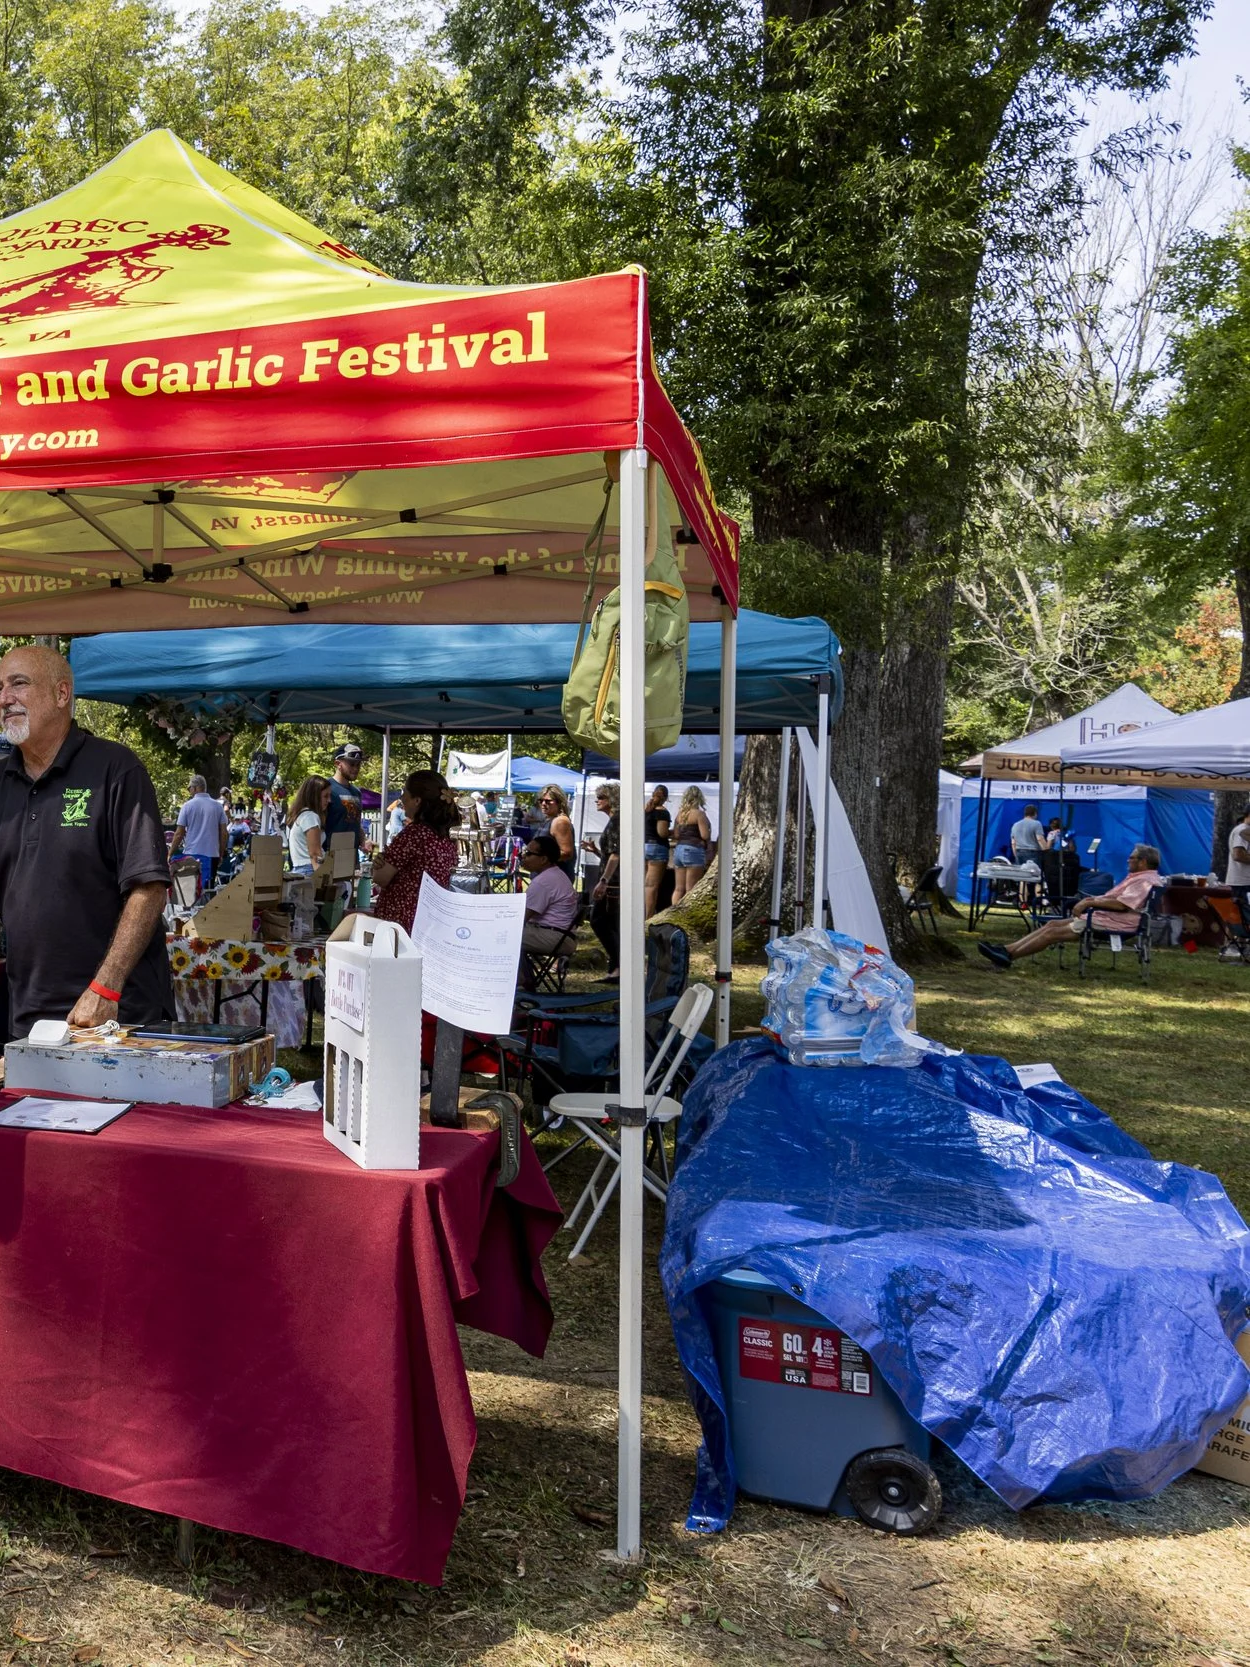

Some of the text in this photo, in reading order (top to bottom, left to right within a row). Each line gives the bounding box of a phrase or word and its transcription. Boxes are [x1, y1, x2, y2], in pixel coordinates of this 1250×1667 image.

[28, 329, 72, 343] VA
[16, 358, 110, 407] and
[122, 344, 285, 397] Garlic
[299, 310, 550, 383] Festival
[743, 1336, 773, 1347] CLASSIC
[783, 1332, 803, 1354] 60
[811, 1336, 823, 1357] 4
[785, 1374, 806, 1384] USA
